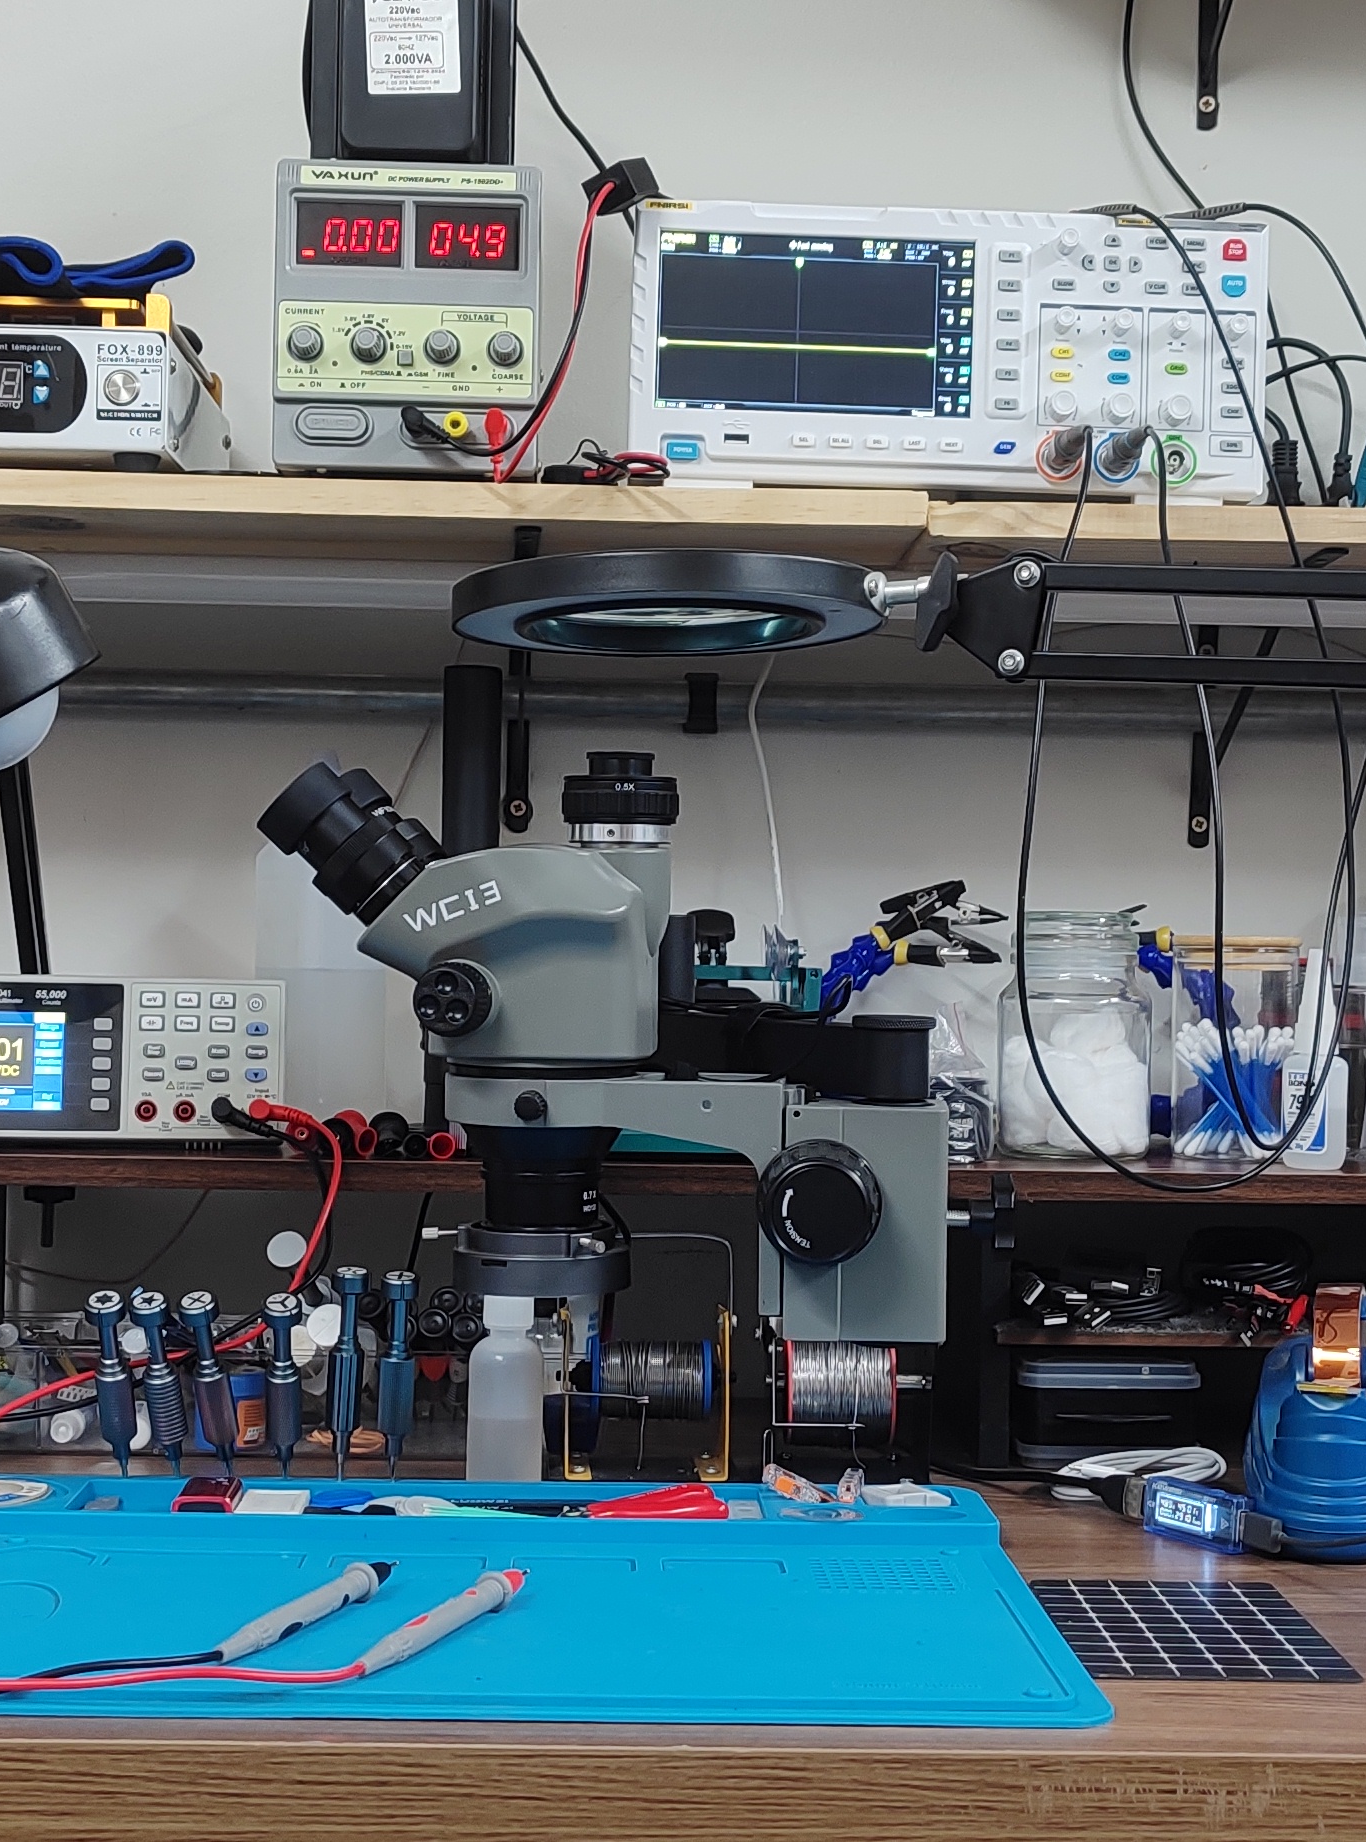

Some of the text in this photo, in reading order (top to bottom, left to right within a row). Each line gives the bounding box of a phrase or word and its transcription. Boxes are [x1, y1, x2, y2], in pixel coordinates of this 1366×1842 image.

[384, 53, 433, 65] 2.000VA
[649, 201, 689, 209] FNIRSI
[429, 222, 506, 258] 04.9
[456, 313, 495, 321] VOLTAGE
[11, 343, 62, 353] temperature
[97, 343, 163, 356] FOX-899
[96, 355, 163, 364] Screen Separator
[451, 384, 470, 392] GND
[35, 989, 67, 999] 55,000
[784, 1219, 812, 1249] TENSION
